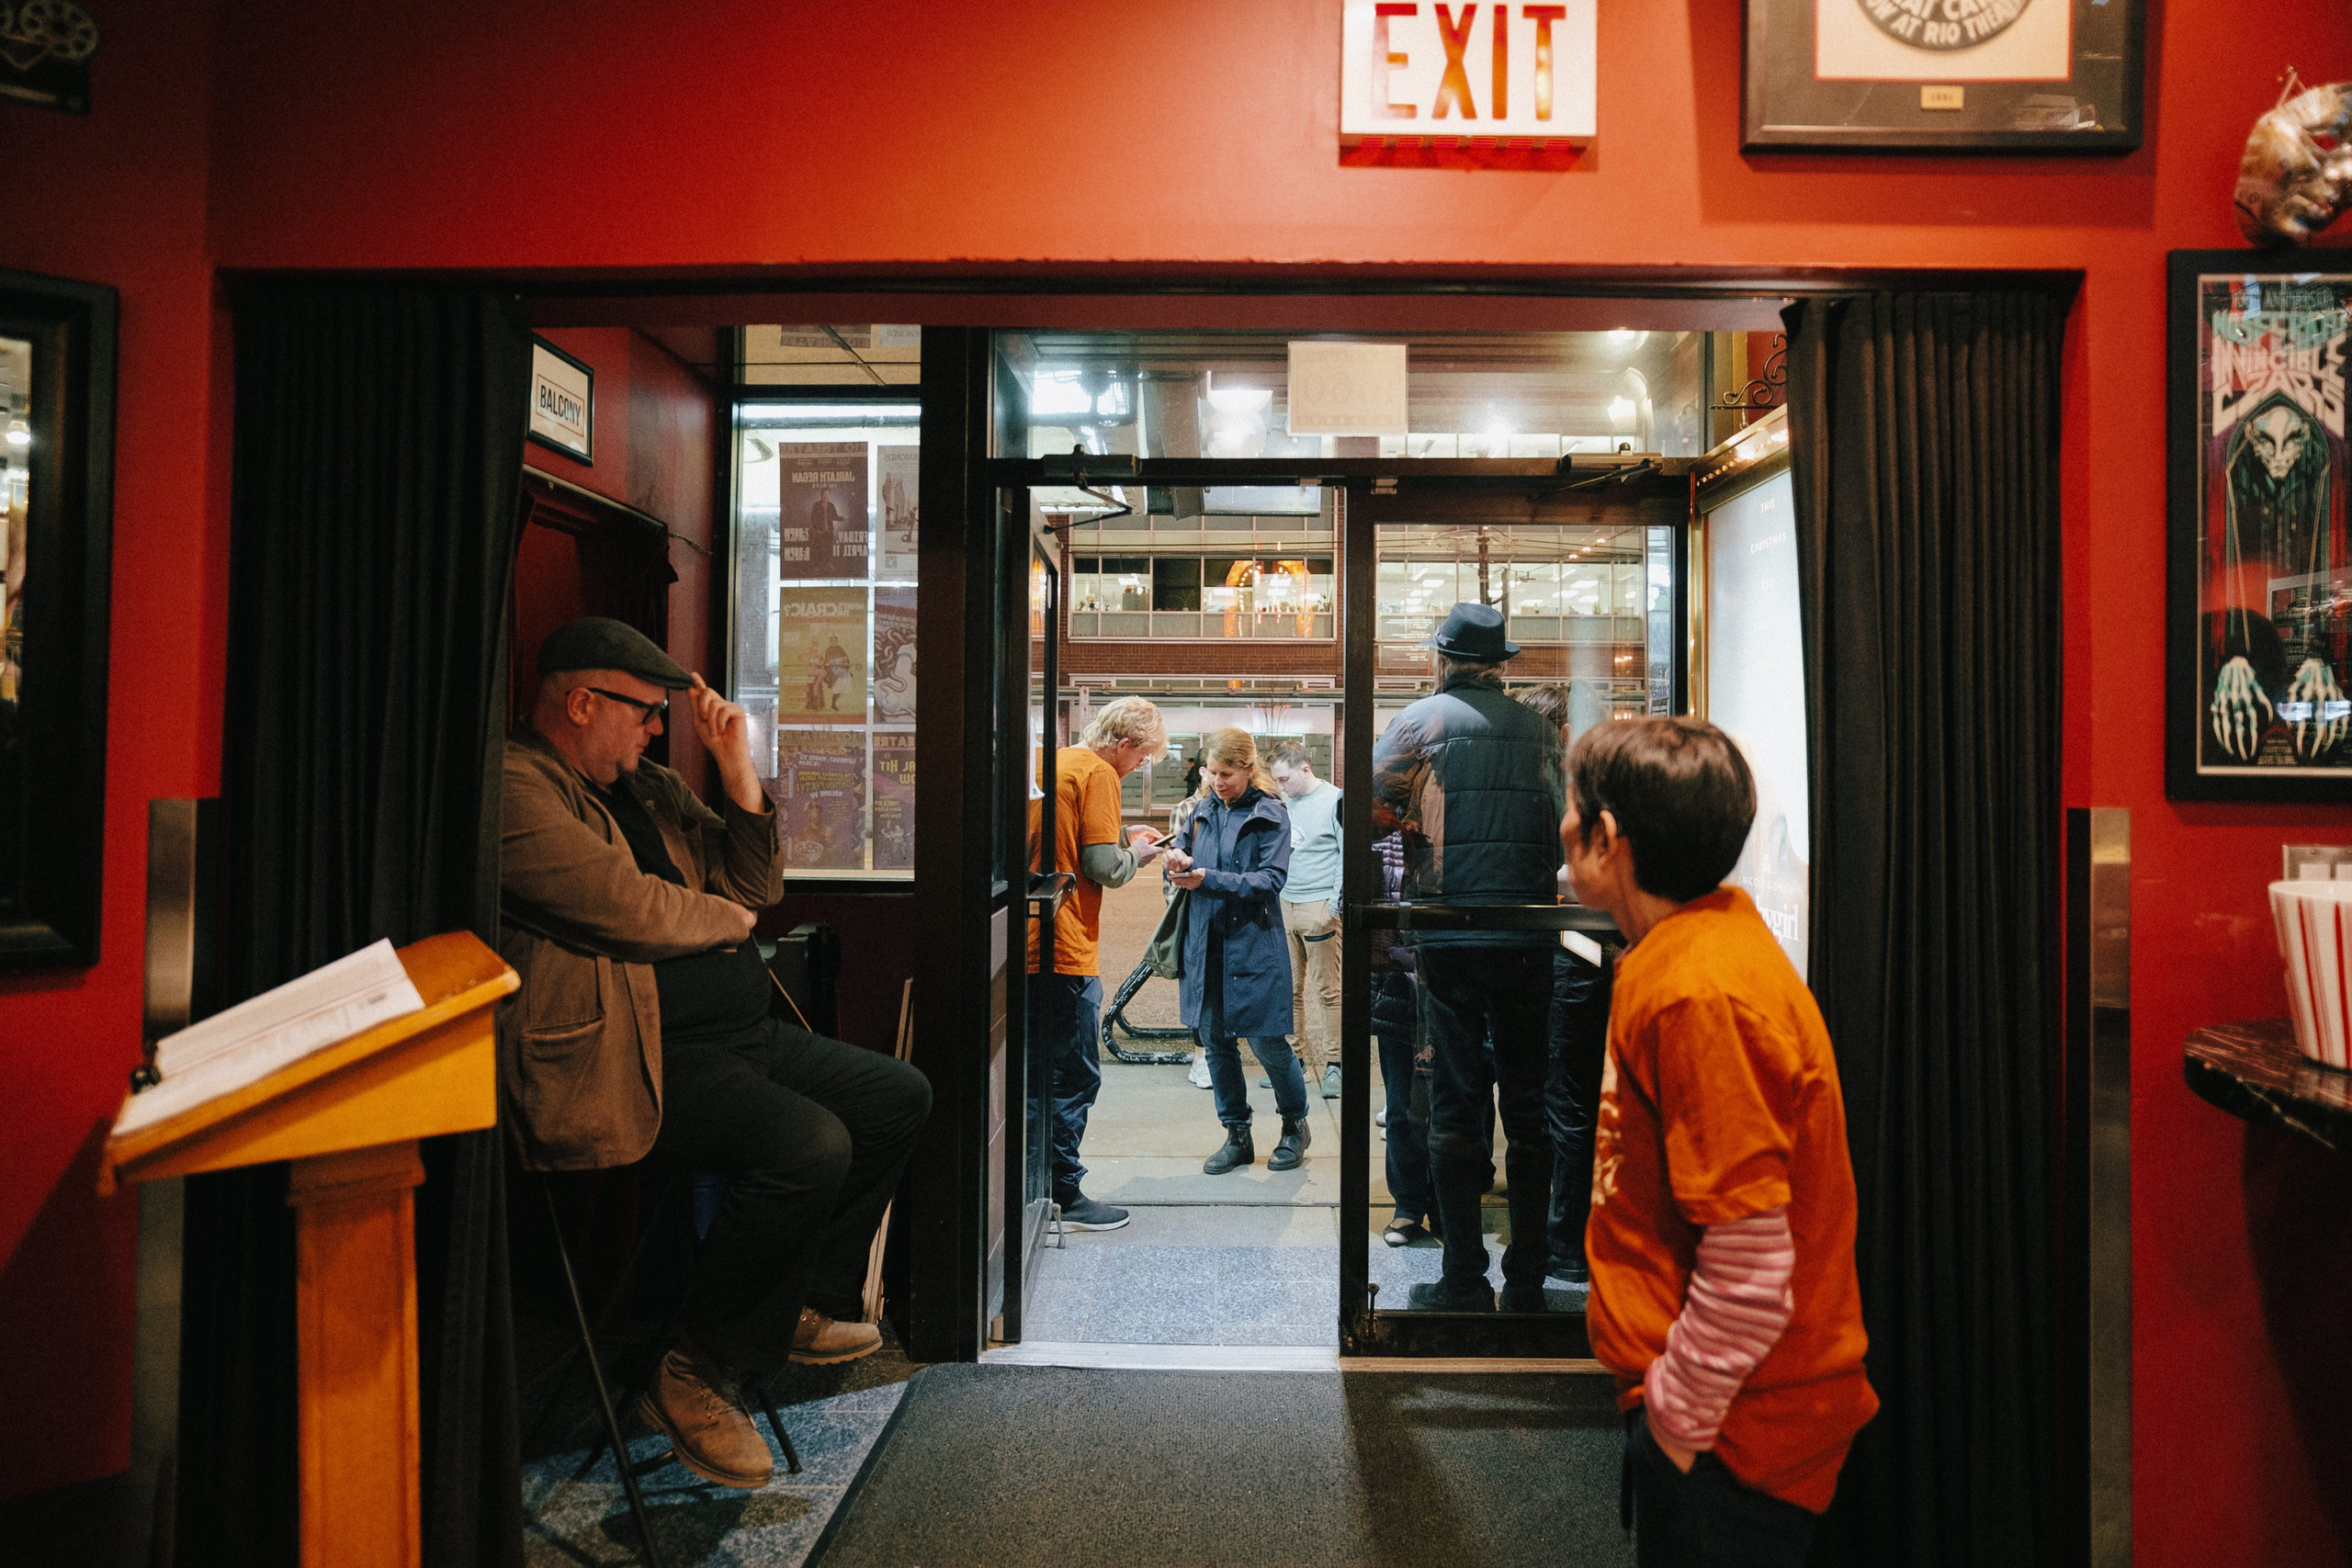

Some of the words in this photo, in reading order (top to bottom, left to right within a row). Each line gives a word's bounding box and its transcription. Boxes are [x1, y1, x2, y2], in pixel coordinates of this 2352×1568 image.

[1890, 13, 1922, 39] AT
[1923, 20, 1962, 44] RIO
[1372, 3, 1566, 120] EXIT
[540, 385, 582, 427] BALCONY
[1760, 497, 1775, 513] THIS
[1749, 531, 1787, 554] CHRISTMAS
[1742, 875, 1766, 889] NICOLE
[1768, 881, 1793, 895] KIDMAN
